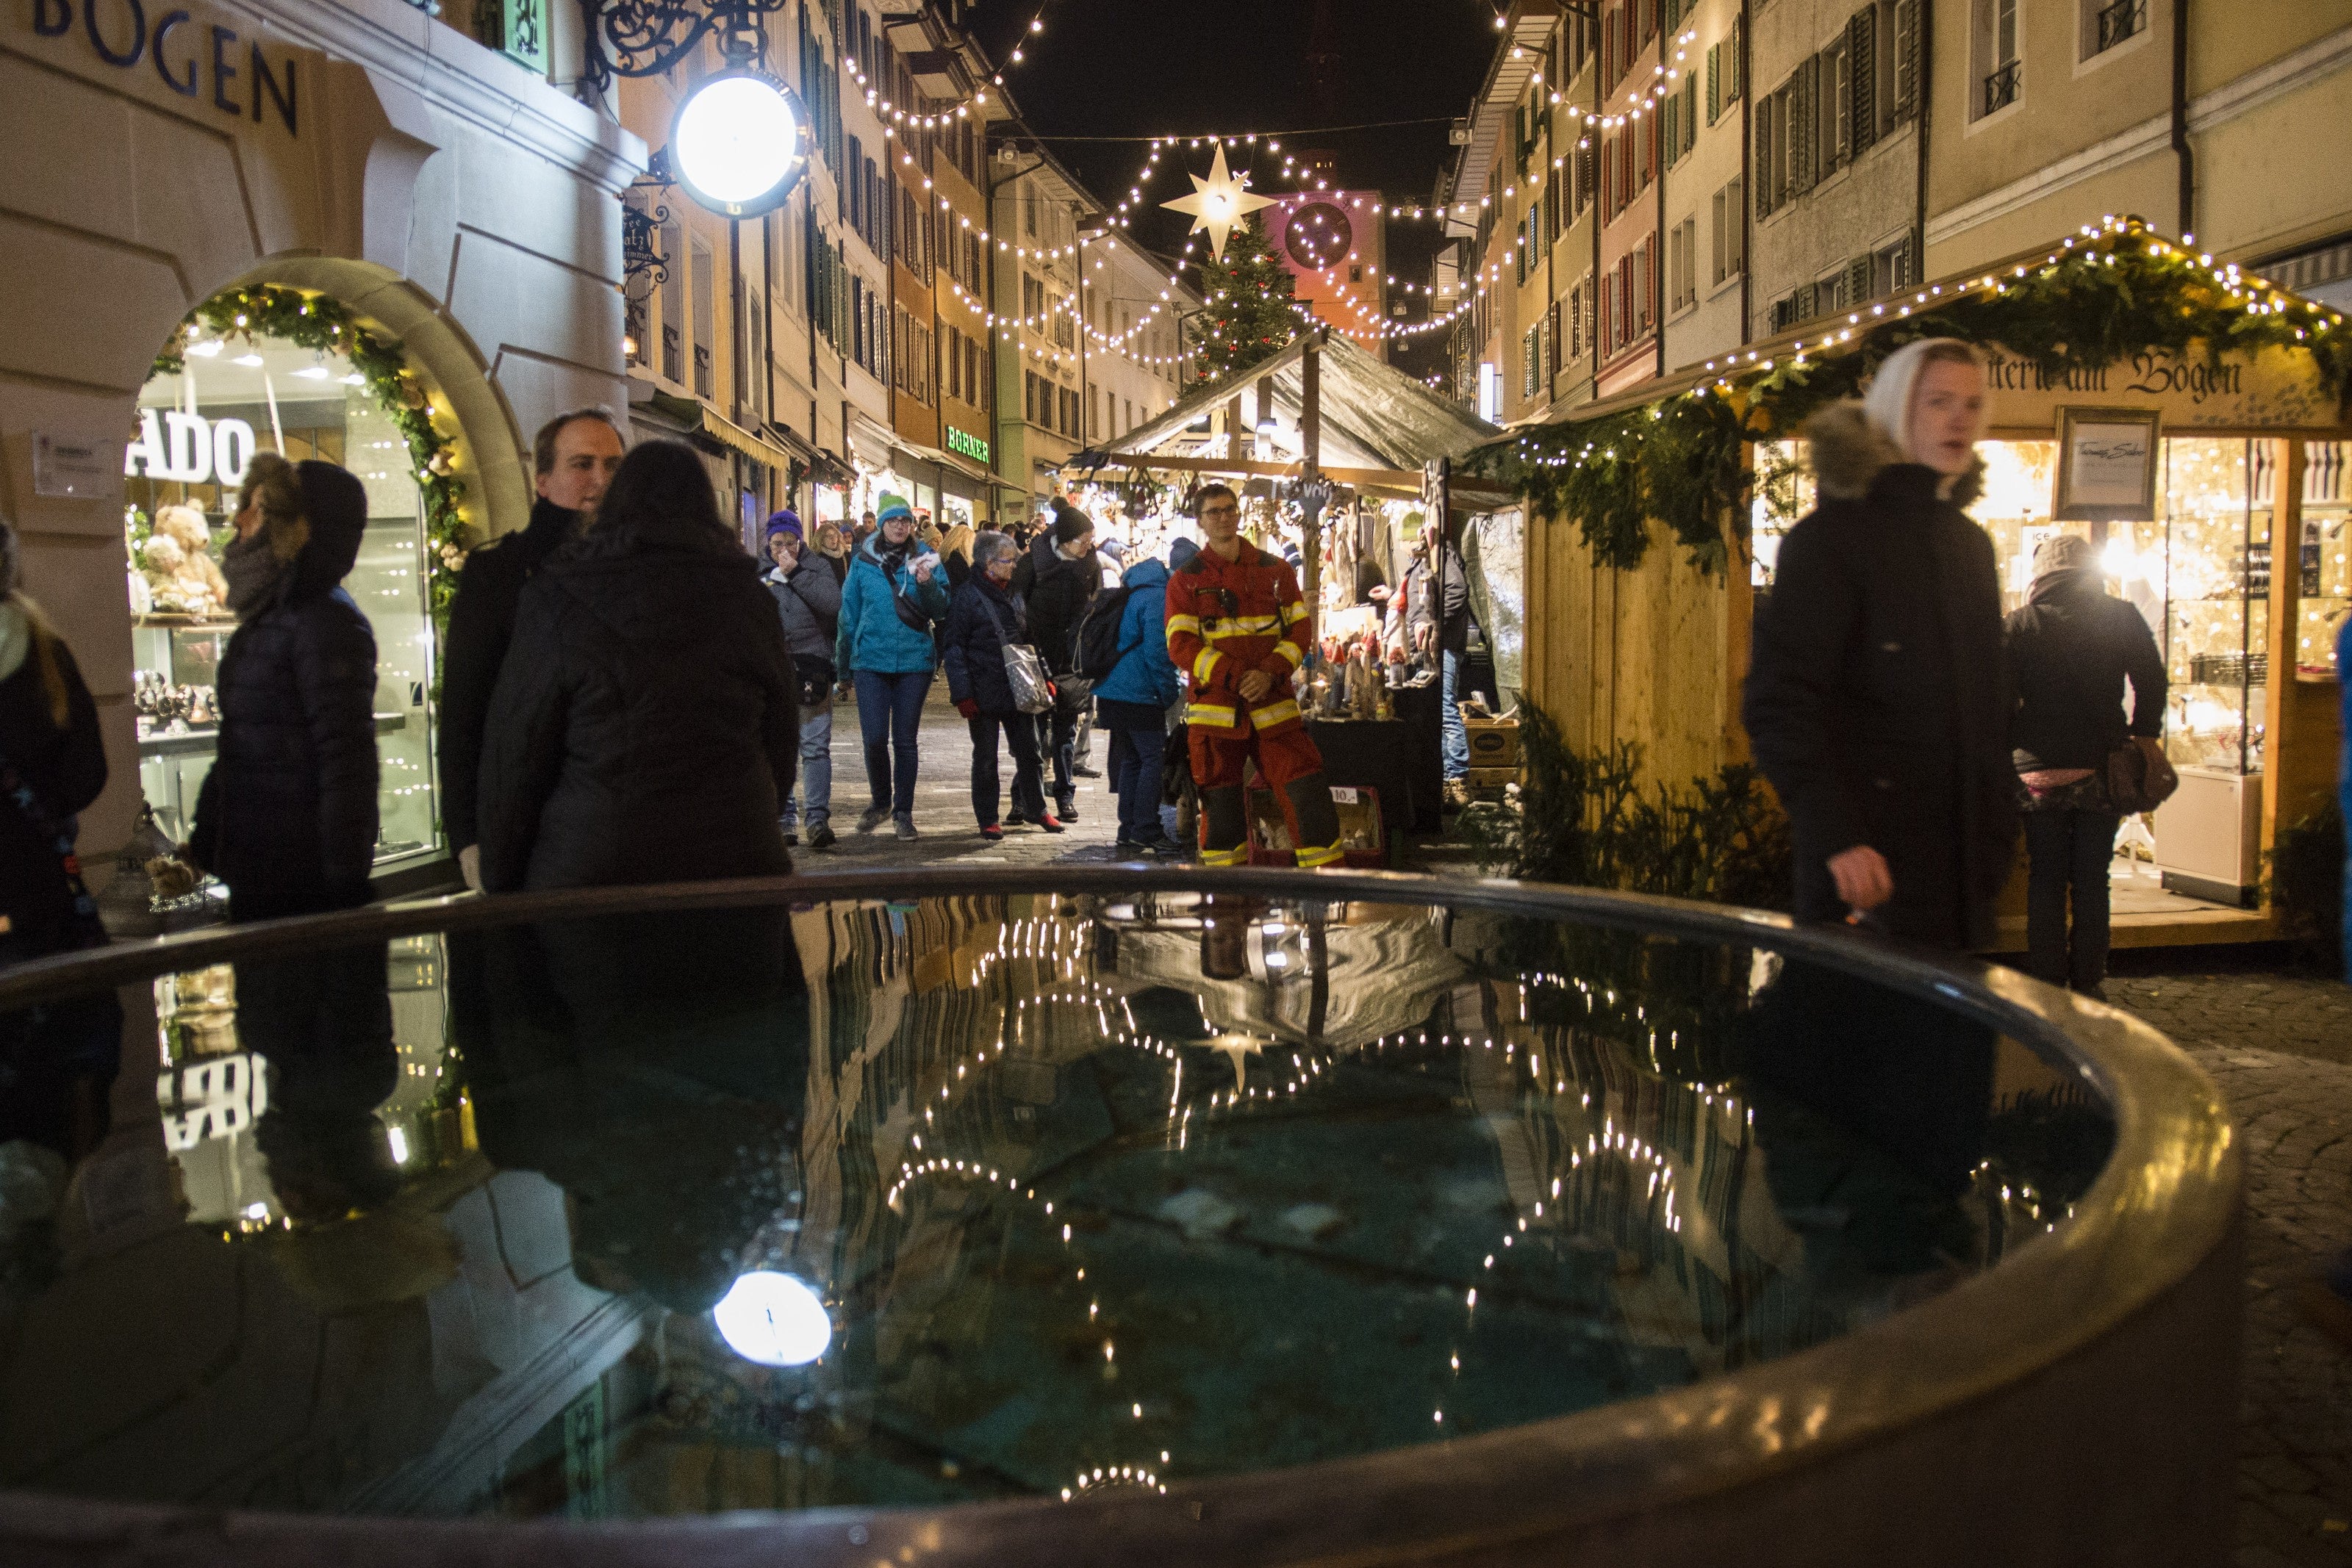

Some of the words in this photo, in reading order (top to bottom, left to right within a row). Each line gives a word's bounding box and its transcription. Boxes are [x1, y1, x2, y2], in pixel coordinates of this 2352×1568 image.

[2124, 351, 2242, 403] Bogen
[125, 409, 255, 487] ADO
[948, 425, 989, 464] BORNER
